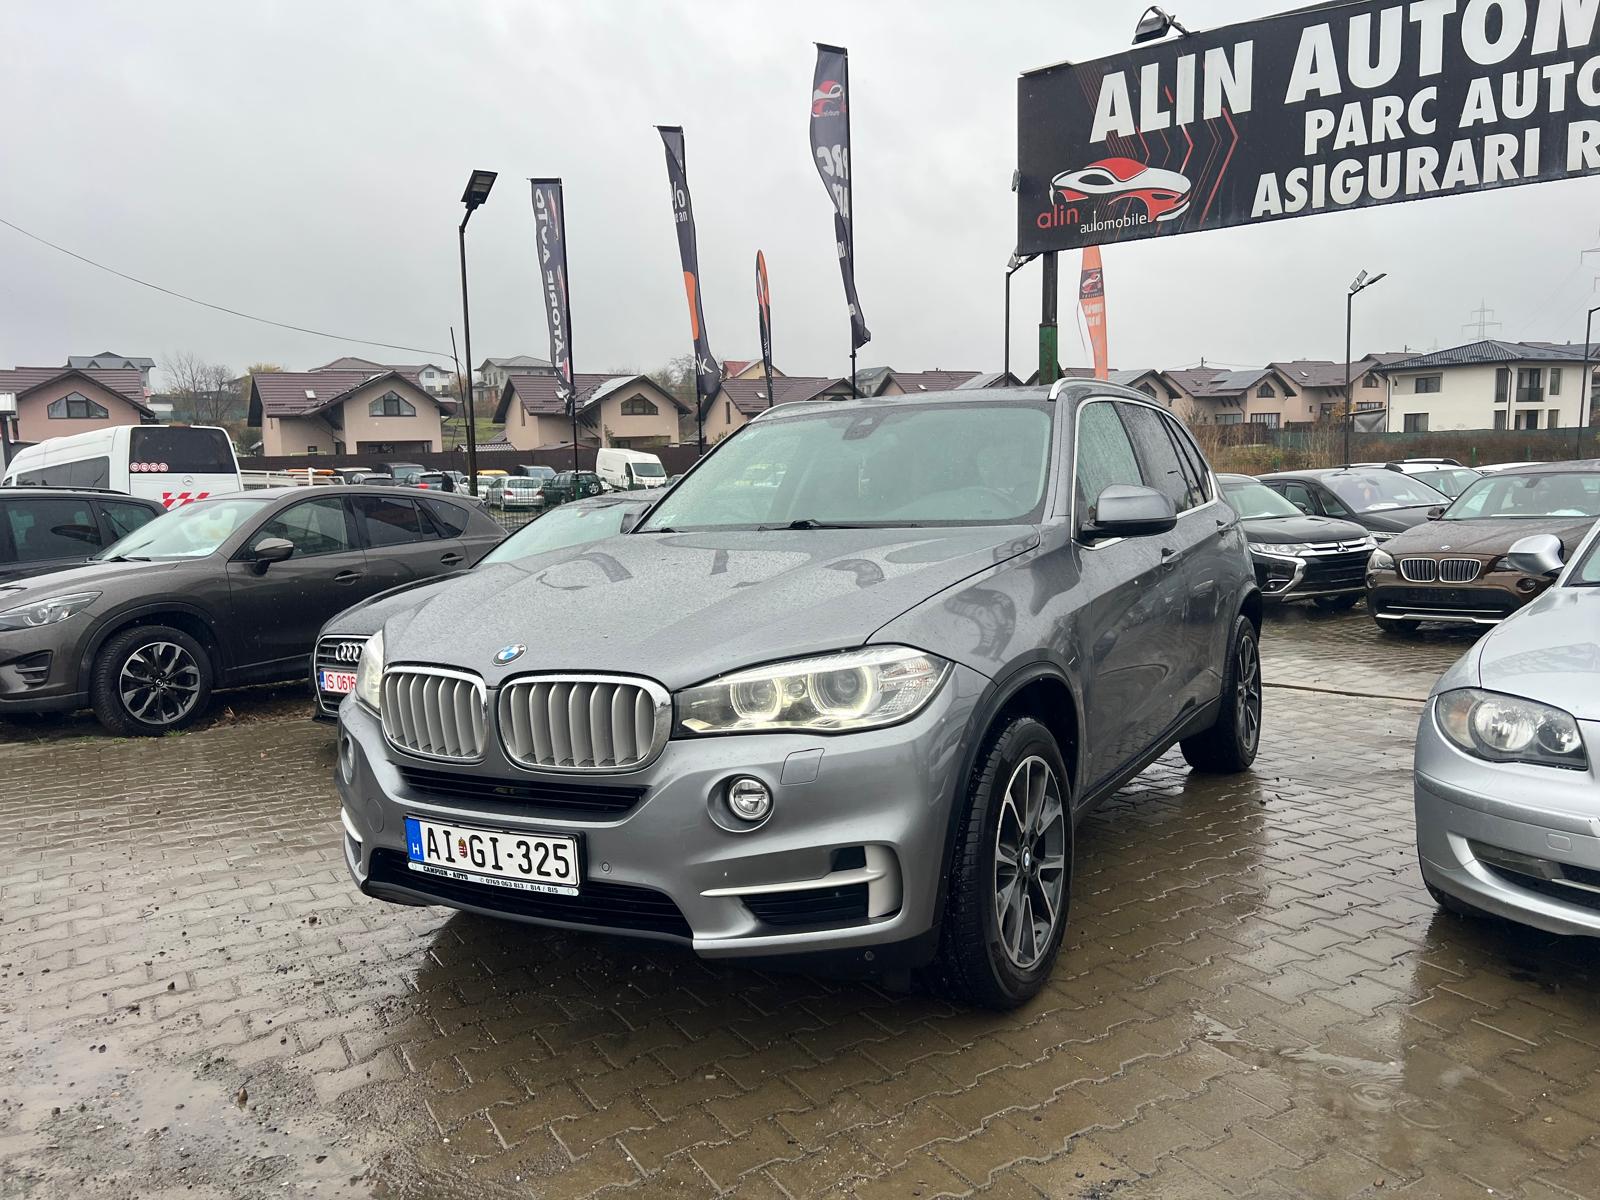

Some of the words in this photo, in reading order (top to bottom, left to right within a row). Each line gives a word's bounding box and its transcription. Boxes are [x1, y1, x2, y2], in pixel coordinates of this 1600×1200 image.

[1089, 39, 1255, 143] ALIN
[1304, 86, 1438, 156] PARC
[1458, 55, 1600, 128] AUTO
[1251, 127, 1540, 219] ASIGURARI
[1036, 203, 1080, 229] alin
[1079, 209, 1148, 234] automobile
[412, 843, 420, 856] H
[427, 827, 456, 863] AI
[468, 834, 570, 879] GI-325
[452, 871, 469, 880] AUTO
